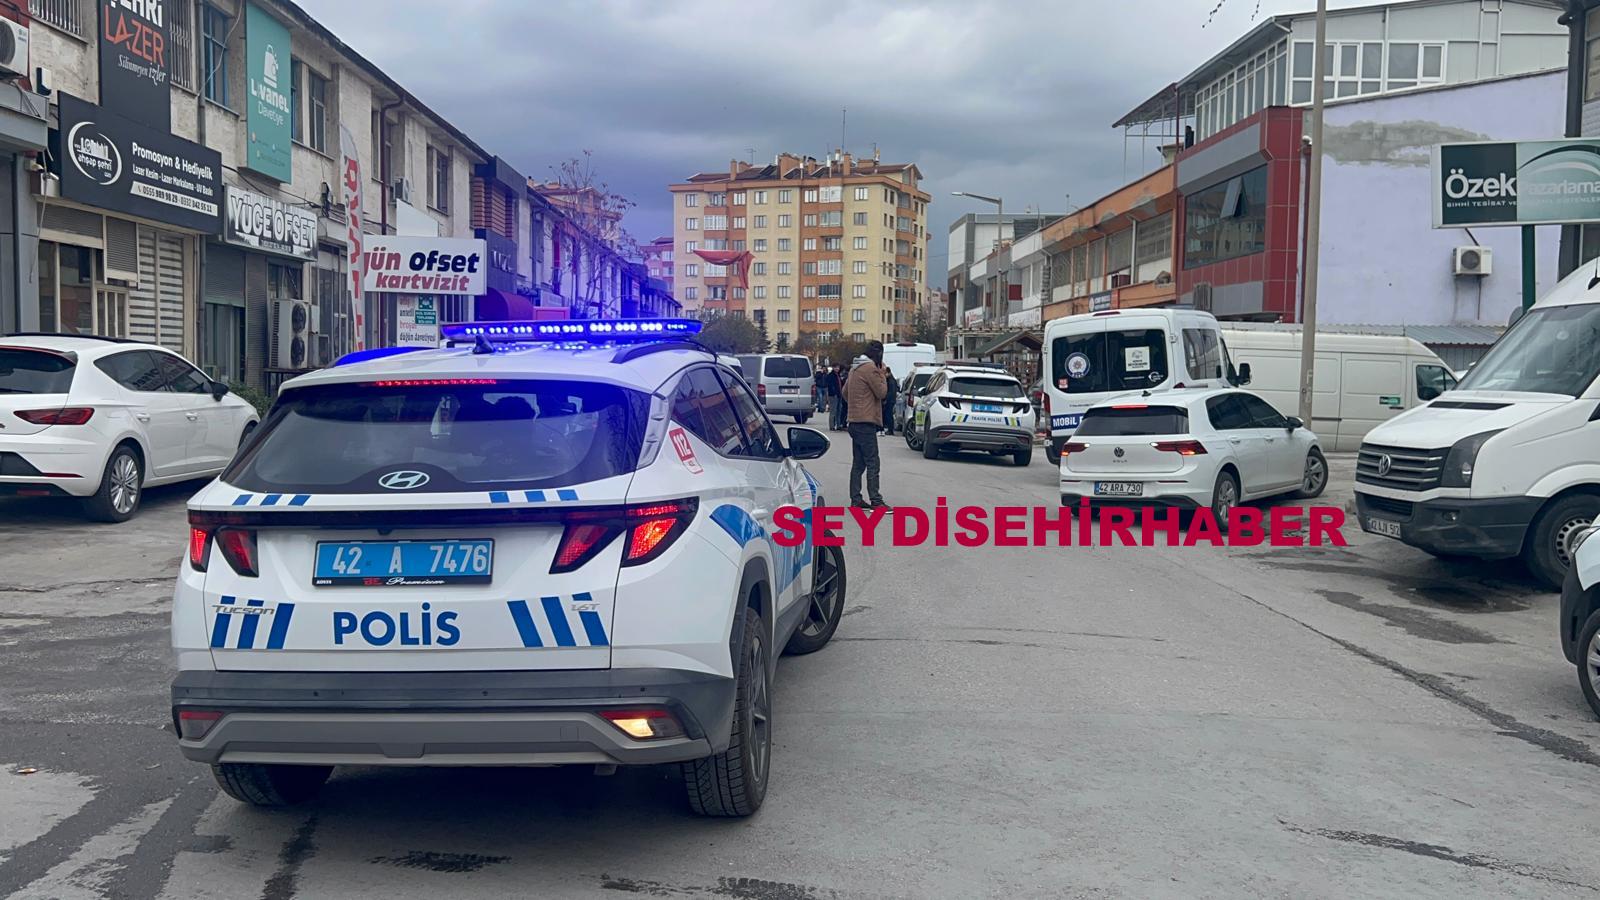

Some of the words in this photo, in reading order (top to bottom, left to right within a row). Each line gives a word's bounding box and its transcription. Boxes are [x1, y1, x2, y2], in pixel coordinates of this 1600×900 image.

[105, 5, 164, 67] LAZER
[132, 142, 173, 167] Promosyon
[175, 156, 180, 169] &
[182, 159, 213, 180] Hediyelik
[132, 163, 145, 176] Lazer
[145, 168, 159, 180] Kesim
[161, 173, 173, 184] Lazer
[1445, 168, 1517, 198] Özek
[1519, 179, 1600, 195] azarlama
[230, 193, 273, 239] YÜCE
[274, 209, 316, 249] OFSET
[409, 250, 480, 273] ofset
[375, 272, 470, 291] kartvizit
[1053, 416, 1077, 427] MOBİL
[673, 433, 691, 457] 112
[1099, 483, 1108, 492] 42
[1110, 483, 1124, 491] ARA
[1126, 484, 1140, 492] 730
[332, 546, 363, 574] 42
[389, 546, 402, 574] A
[430, 545, 488, 573] 7476
[333, 602, 461, 646] POLİS
